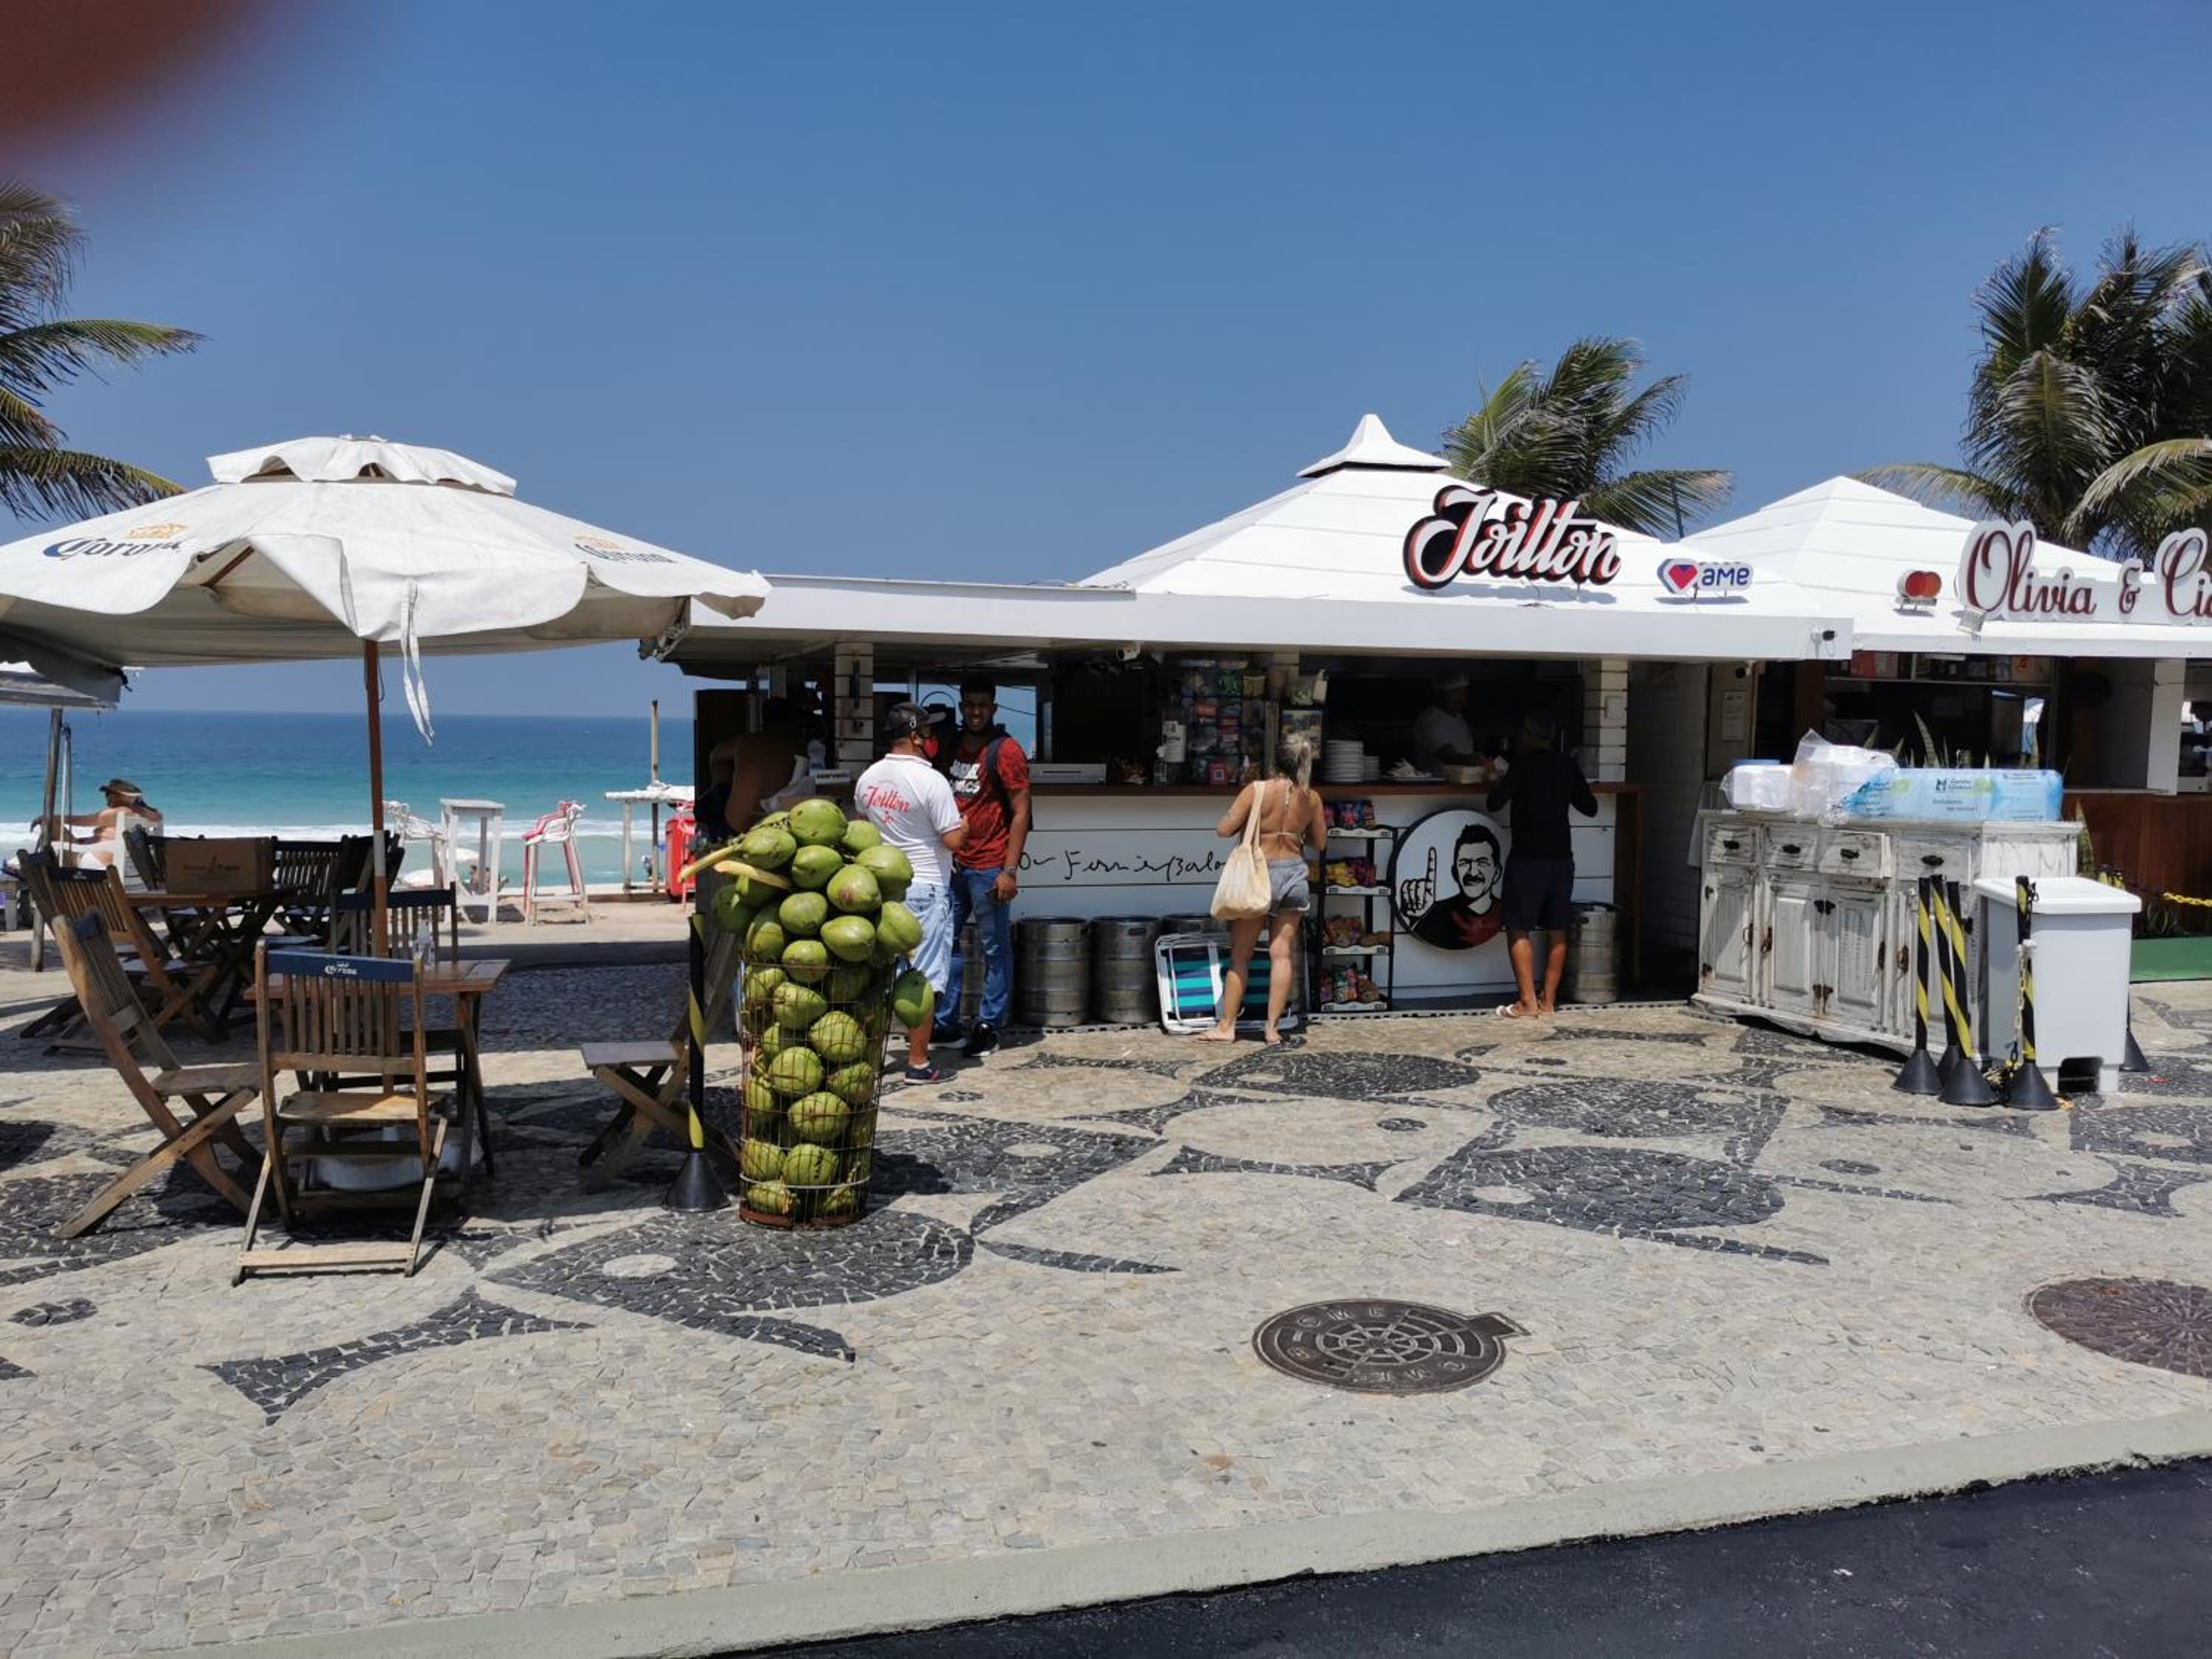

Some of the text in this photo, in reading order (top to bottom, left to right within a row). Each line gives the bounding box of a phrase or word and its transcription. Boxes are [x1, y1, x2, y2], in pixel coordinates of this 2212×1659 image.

[1404, 487, 1621, 587] Joilton
[1966, 529, 2097, 615] Olivia
[2119, 566, 2140, 614] &
